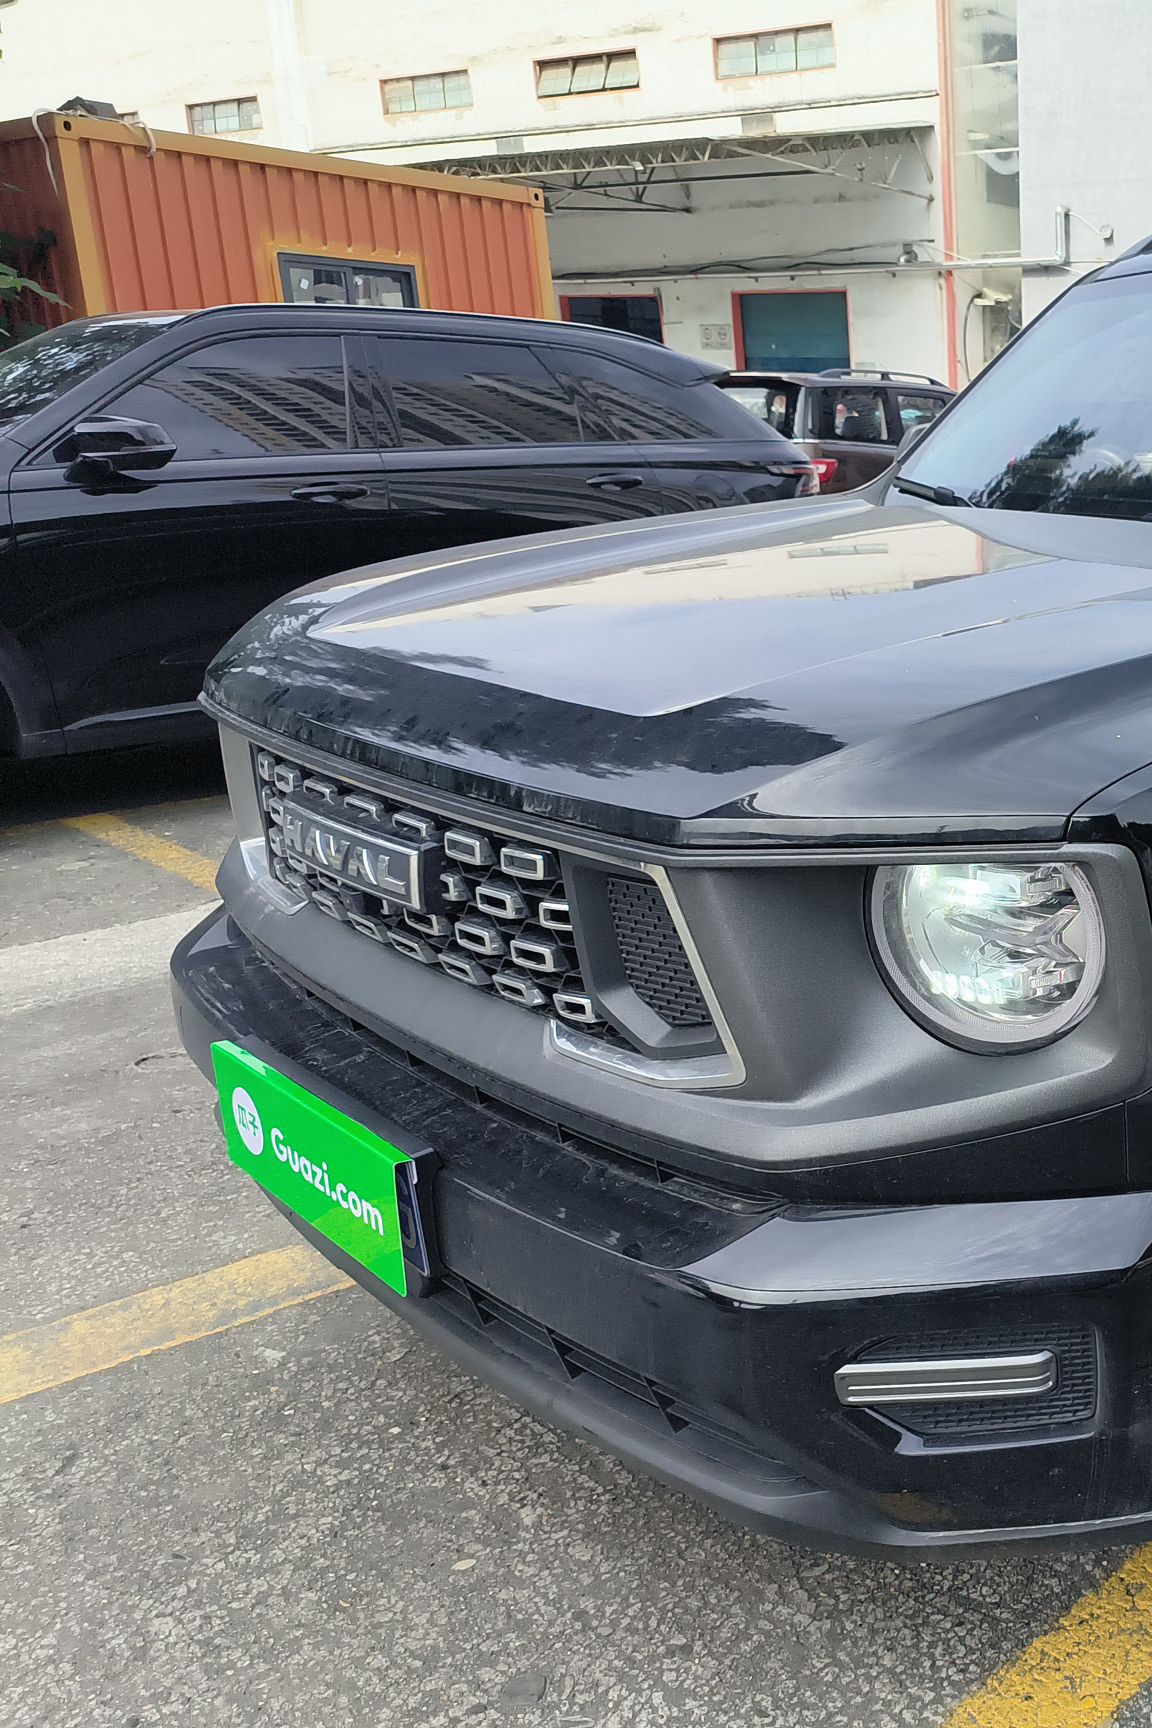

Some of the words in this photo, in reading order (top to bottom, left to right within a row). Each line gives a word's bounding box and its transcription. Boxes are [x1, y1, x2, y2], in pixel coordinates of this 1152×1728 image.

[284, 813, 407, 896] HAVAL
[237, 1103, 260, 1137] 瓜子
[271, 1127, 385, 1237] Guazi.com
